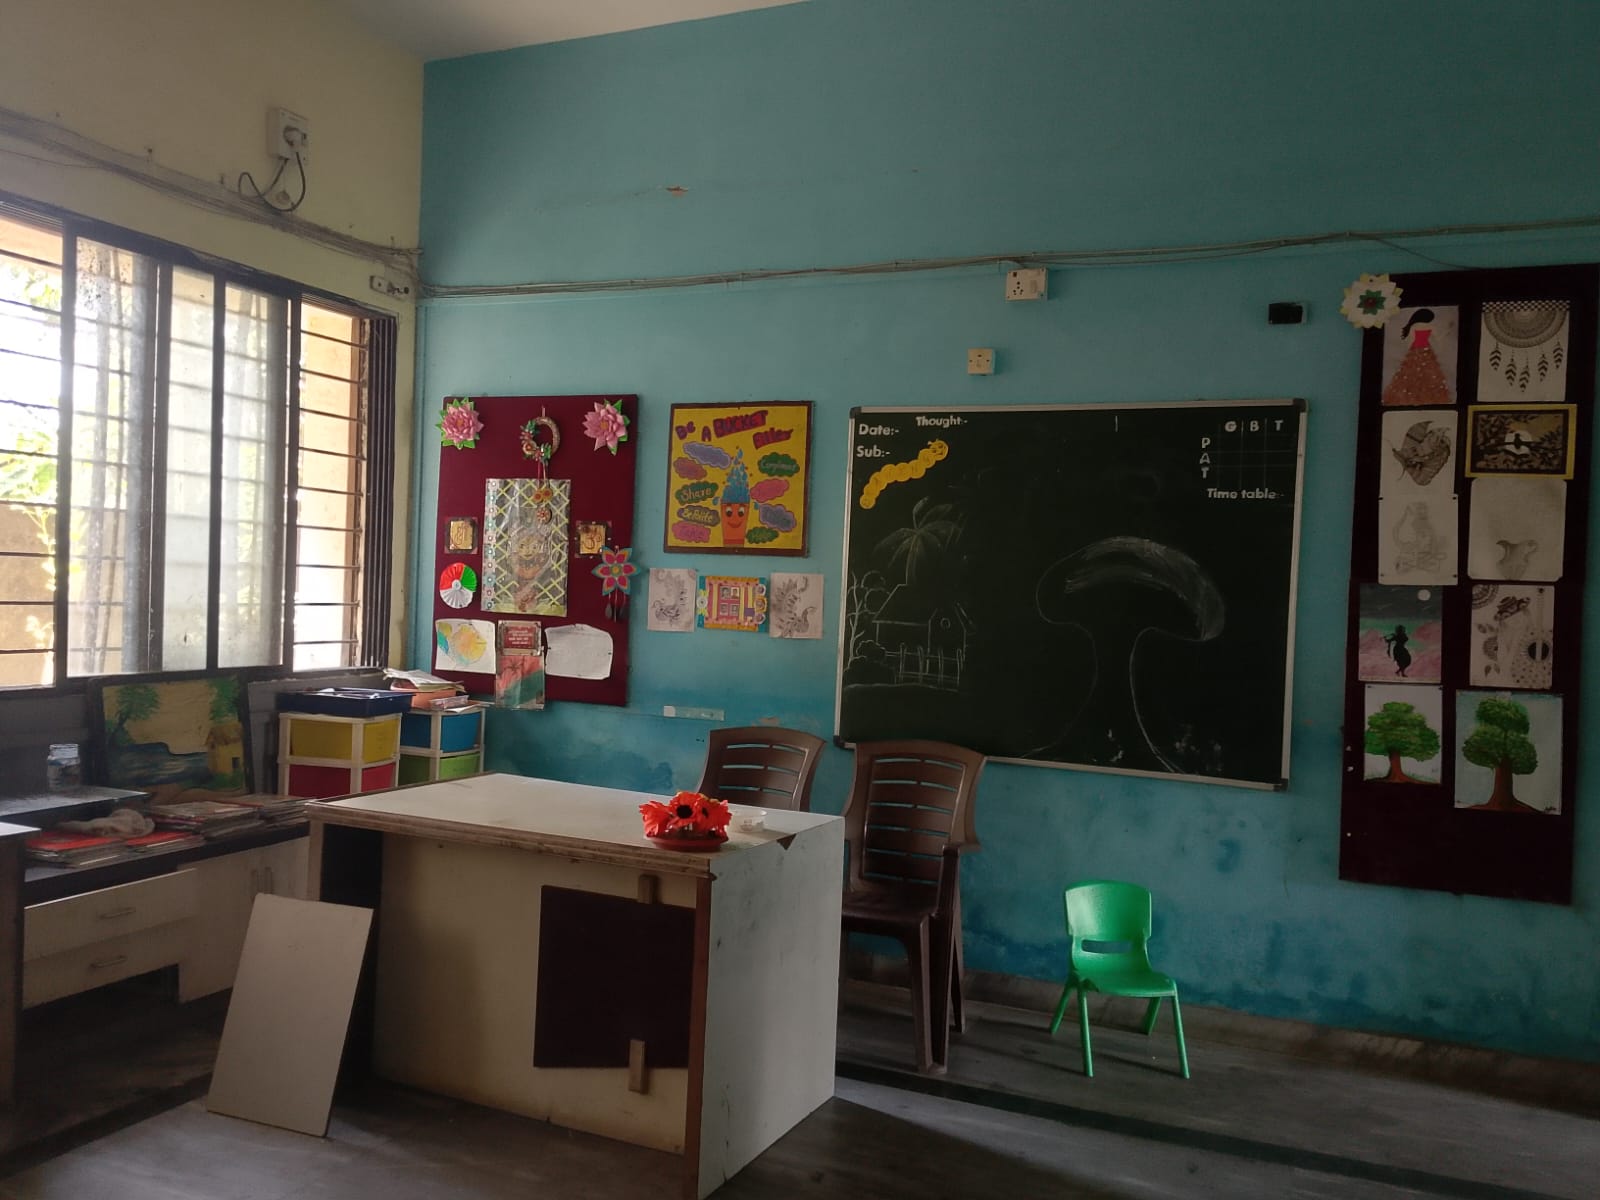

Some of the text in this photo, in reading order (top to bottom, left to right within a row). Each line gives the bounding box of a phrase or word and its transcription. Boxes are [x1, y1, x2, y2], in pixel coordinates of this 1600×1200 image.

[1224, 420, 1283, 432] G B T
[1201, 437, 1211, 448] P
[1200, 452, 1210, 464] A
[1201, 466, 1209, 479] T
[682, 488, 712, 500] Share
[1207, 487, 1238, 499] Time
